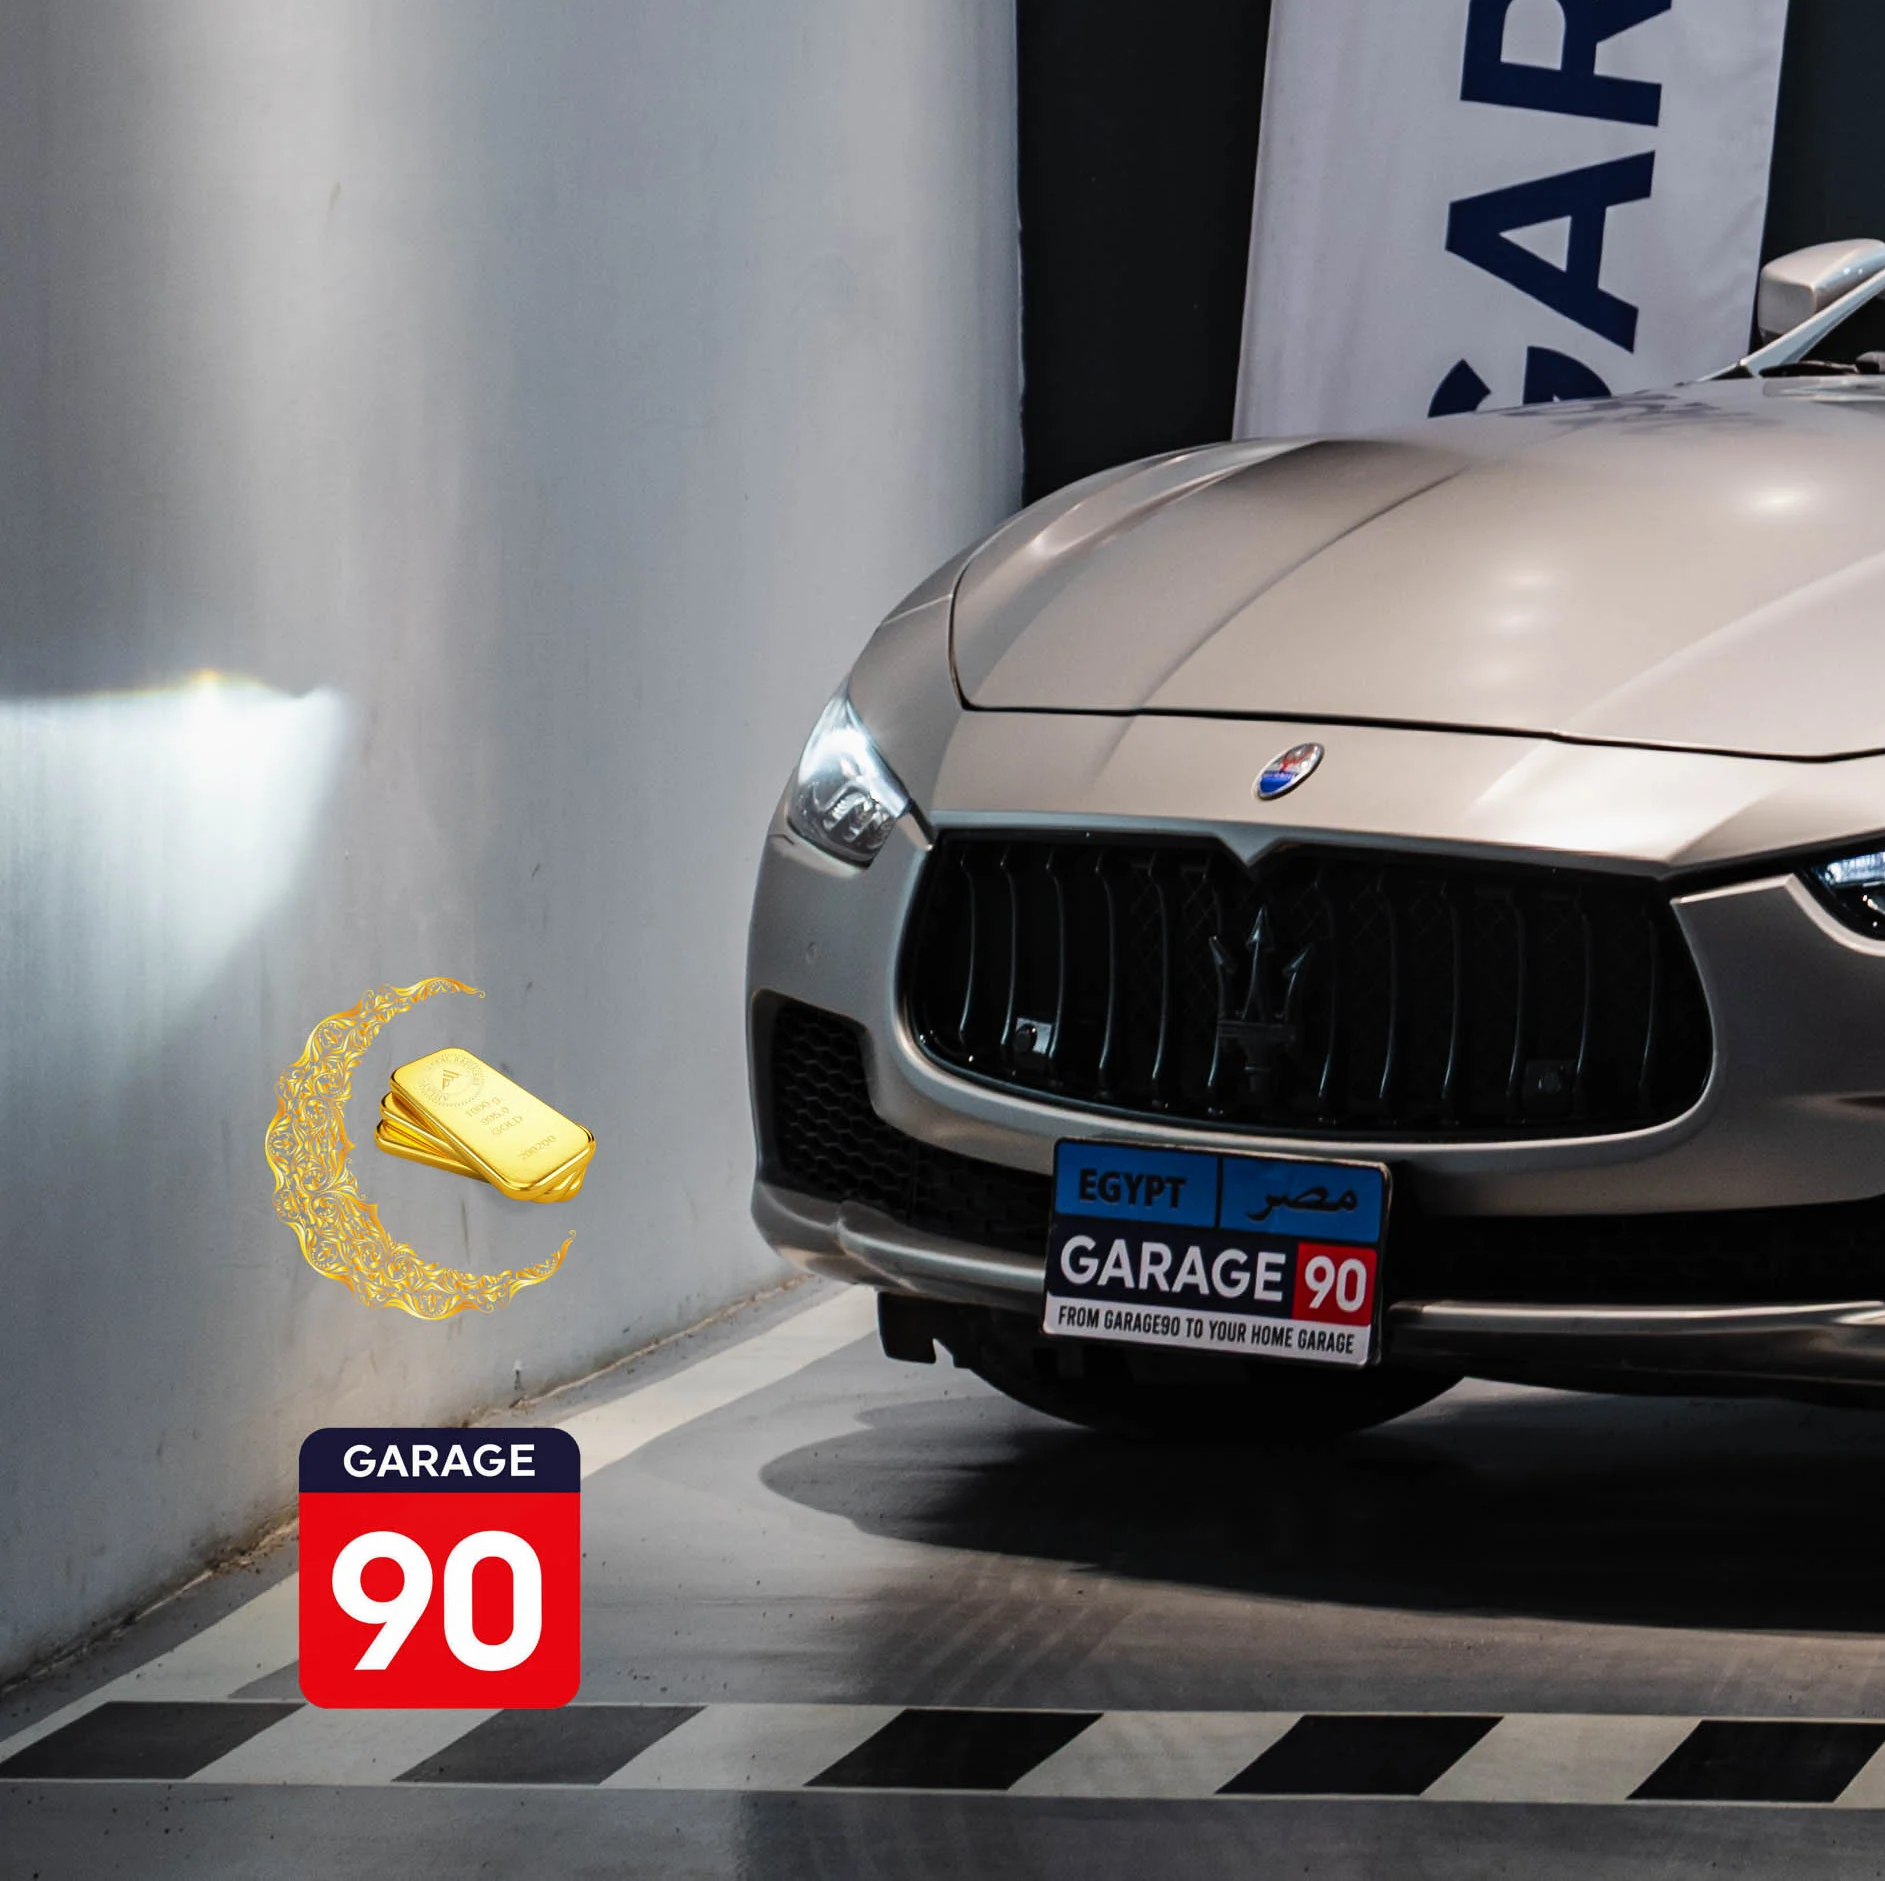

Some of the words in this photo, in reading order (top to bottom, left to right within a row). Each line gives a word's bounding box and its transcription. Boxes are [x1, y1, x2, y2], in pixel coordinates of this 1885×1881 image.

[1078, 1167, 1186, 1209] EGYPT
[1244, 1184, 1358, 1222] مصر
[1060, 1235, 1287, 1302] GARAGE
[1304, 1255, 1367, 1312] 90
[1057, 1304, 1100, 1330] FROM
[1103, 1309, 1181, 1337] GARAGE90
[1185, 1318, 1204, 1340] TO
[1208, 1319, 1247, 1344] YOUR
[1250, 1324, 1294, 1348] HOME
[1297, 1329, 1356, 1354] GARAGE
